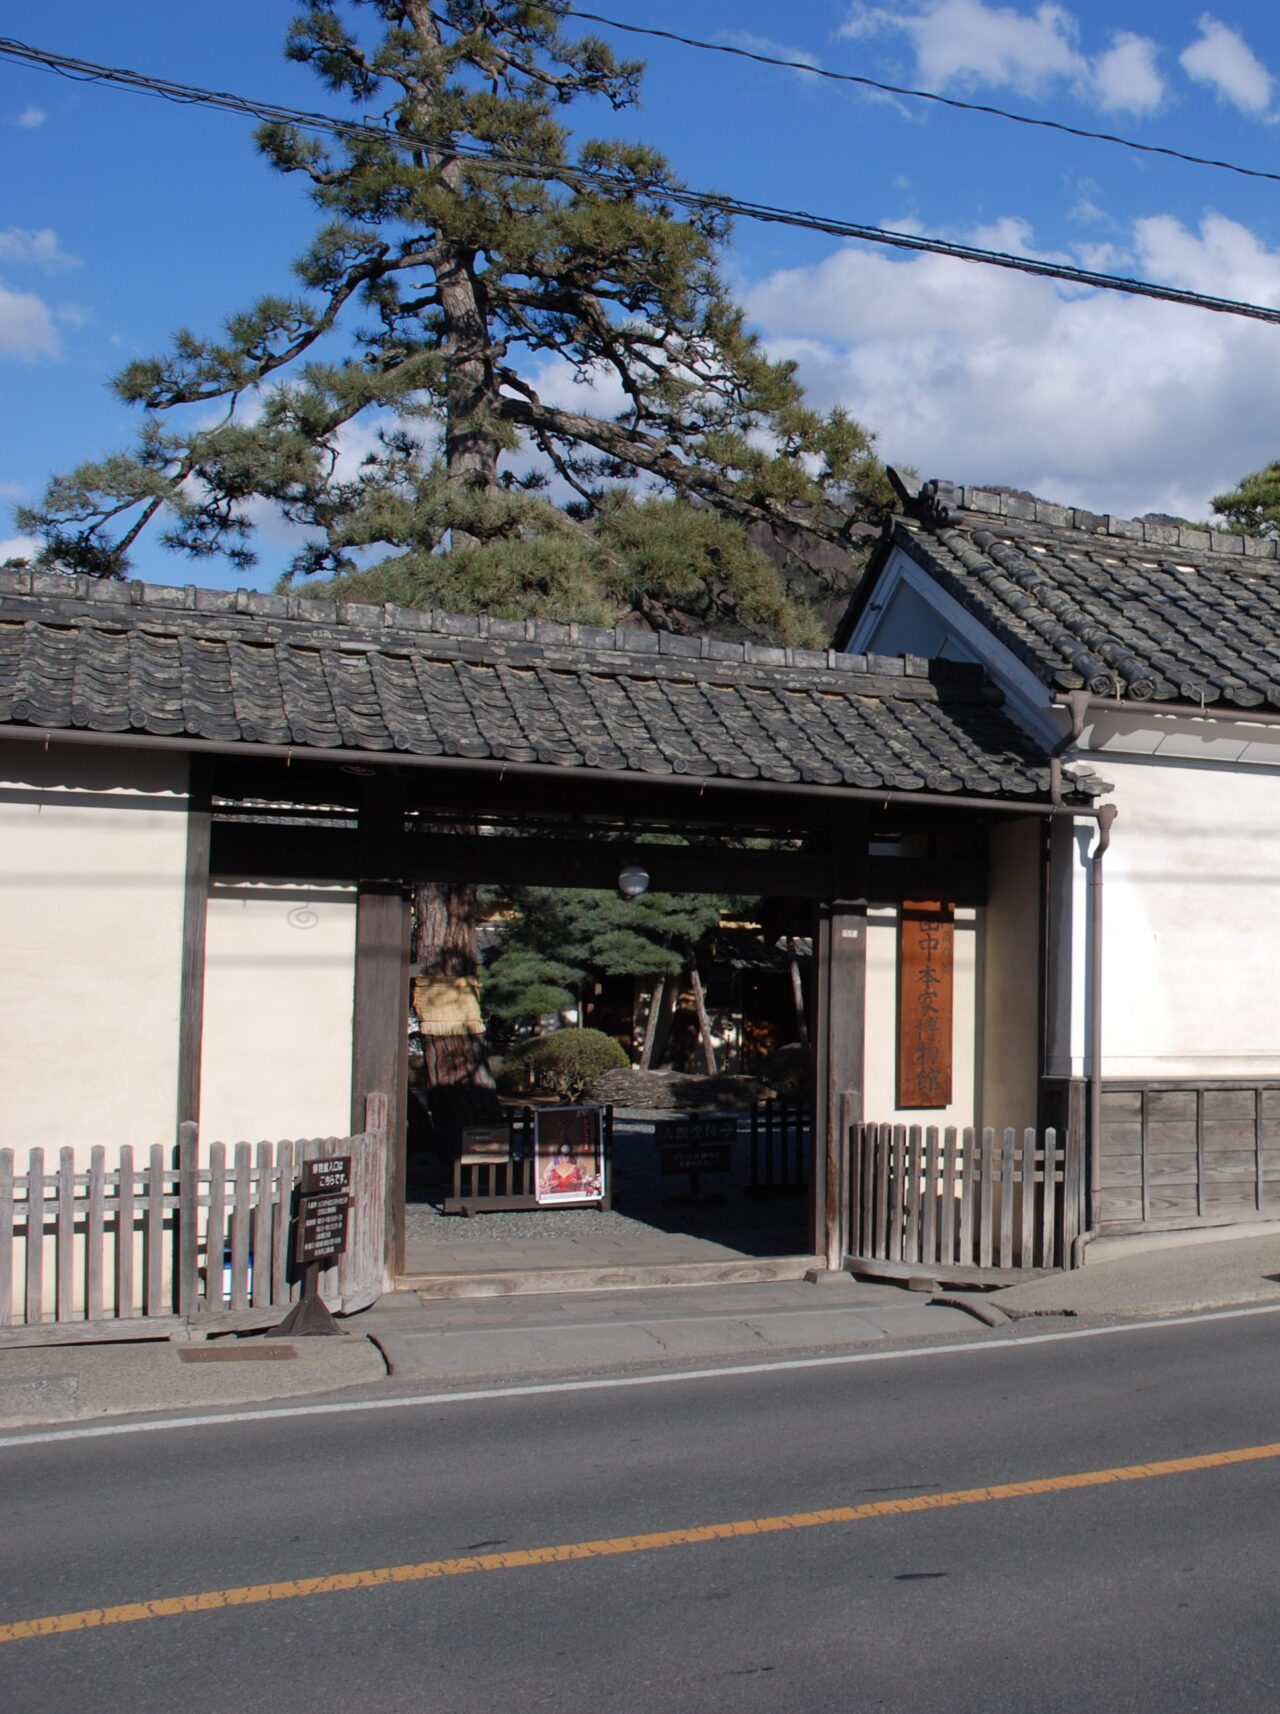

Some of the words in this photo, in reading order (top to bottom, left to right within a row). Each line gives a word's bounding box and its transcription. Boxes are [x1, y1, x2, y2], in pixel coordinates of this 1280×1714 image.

[320, 1174, 347, 1186] こちらです。
